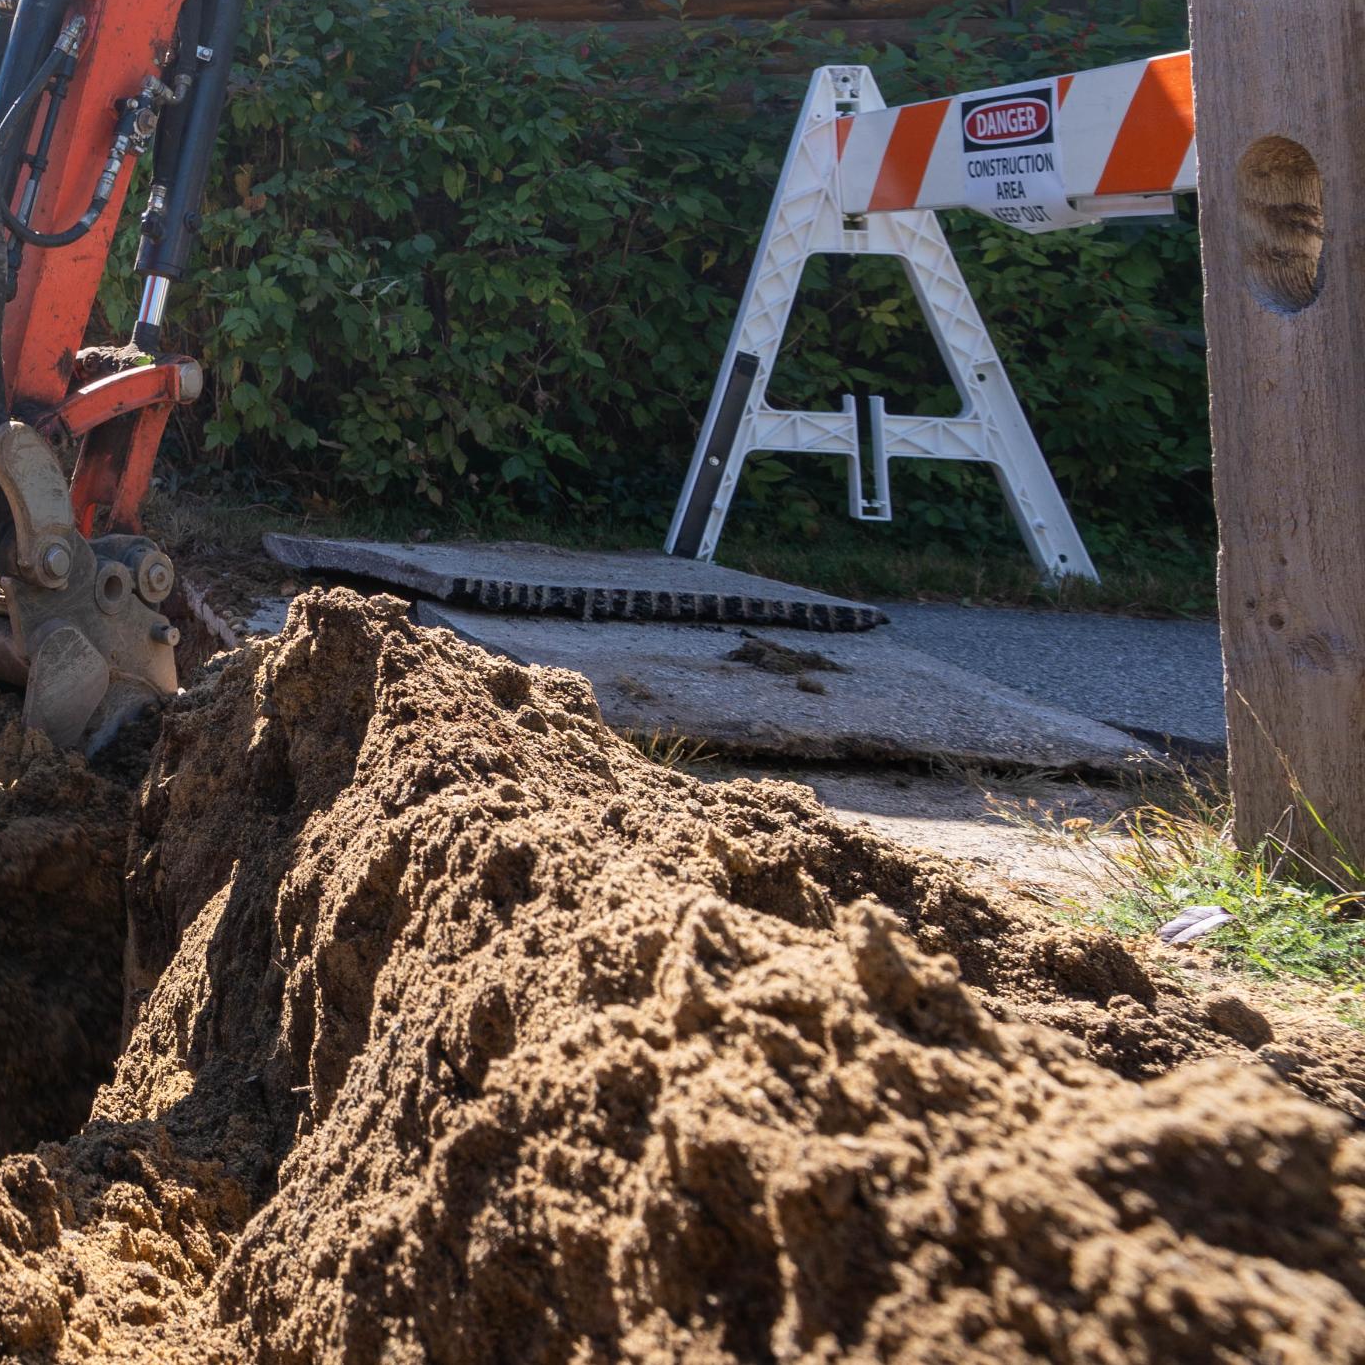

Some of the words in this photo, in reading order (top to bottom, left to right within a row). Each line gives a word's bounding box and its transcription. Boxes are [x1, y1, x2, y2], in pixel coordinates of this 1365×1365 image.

[976, 106, 1038, 137] DANGER
[967, 153, 1054, 178] CONSTRUCTION
[996, 181, 1026, 200] AREA
[991, 207, 1022, 223] KEEP
[1020, 205, 1052, 223] OUT
